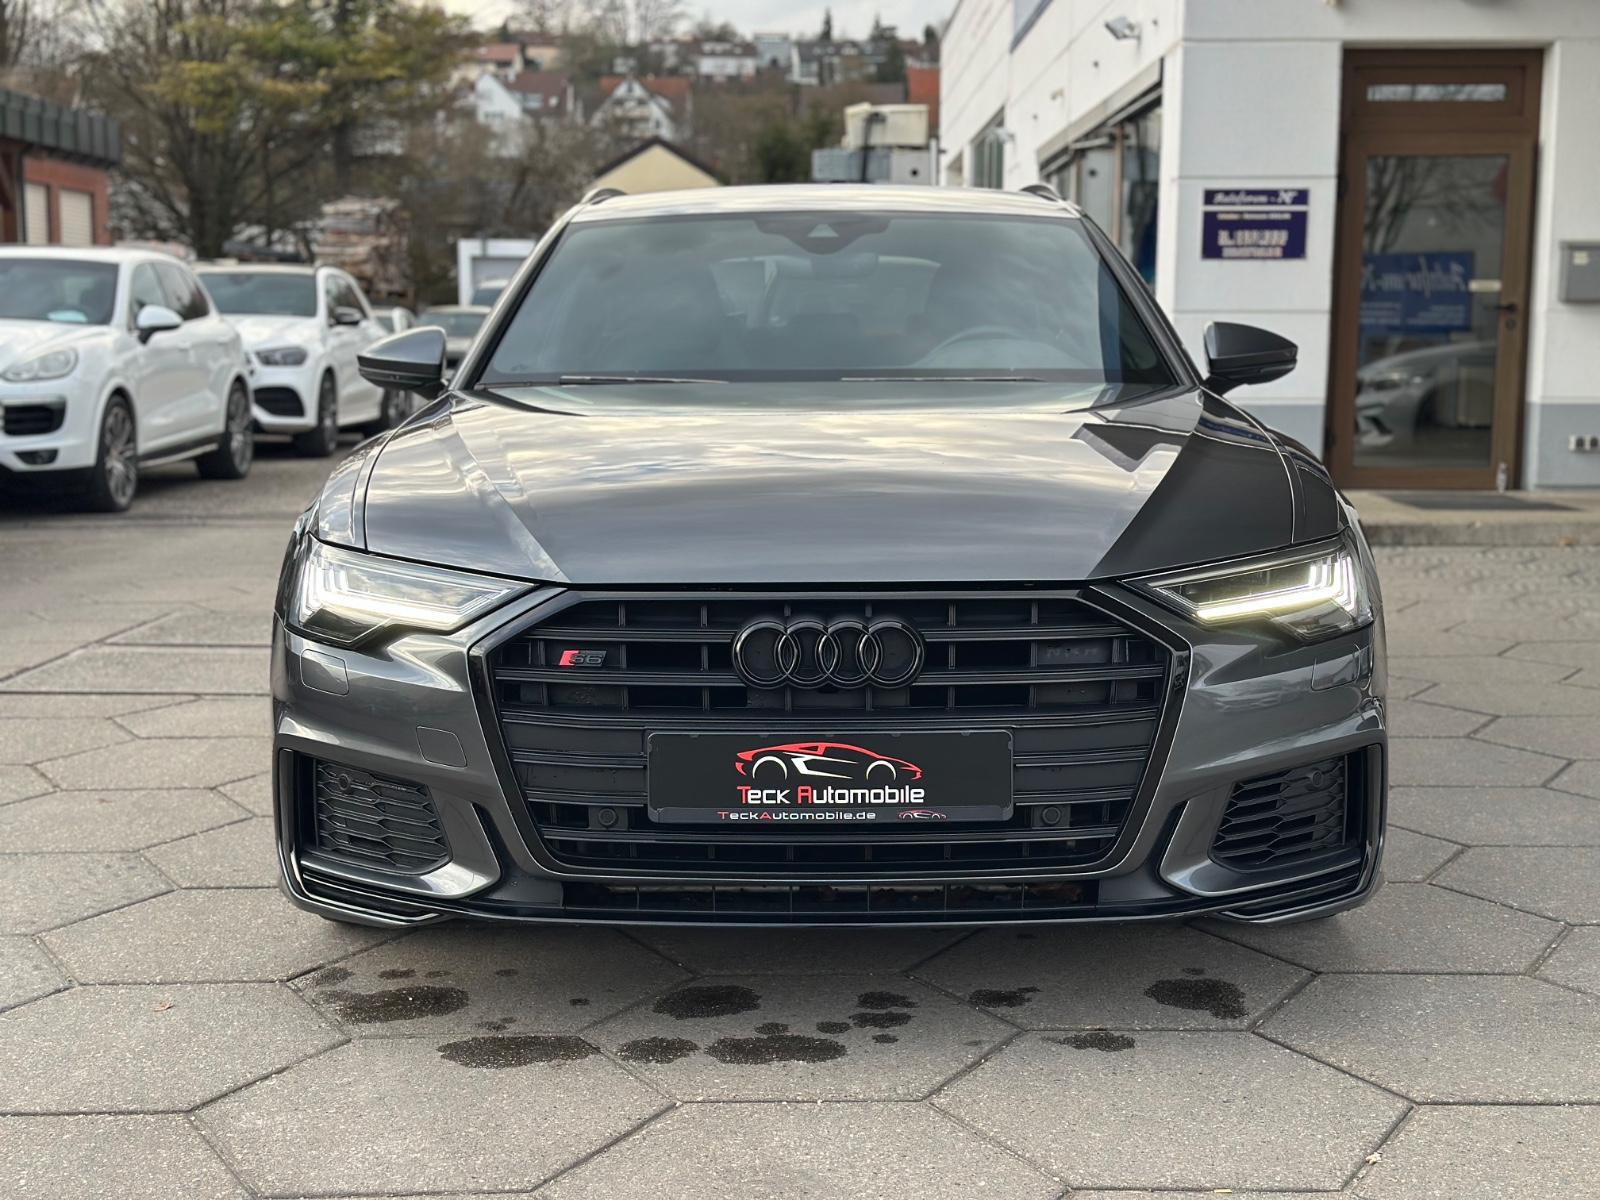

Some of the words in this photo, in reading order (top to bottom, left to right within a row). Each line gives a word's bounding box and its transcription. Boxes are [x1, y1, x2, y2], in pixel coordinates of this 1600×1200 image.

[566, 653, 604, 666] S6
[797, 785, 925, 804] Automobile
[717, 811, 876, 821] TeckAutomobile.de
